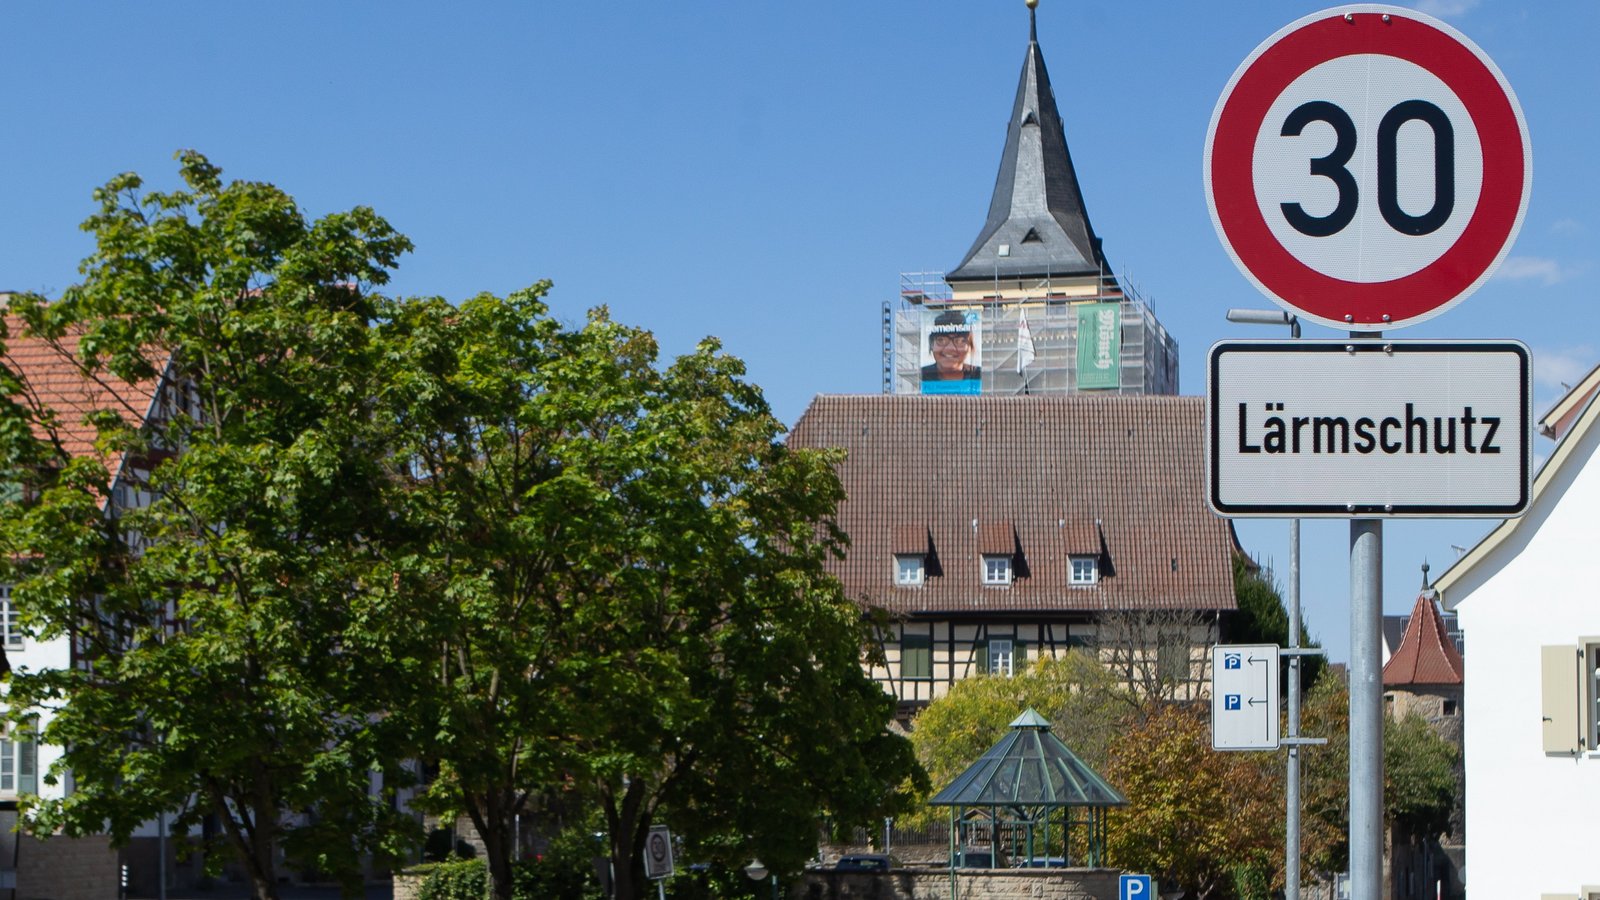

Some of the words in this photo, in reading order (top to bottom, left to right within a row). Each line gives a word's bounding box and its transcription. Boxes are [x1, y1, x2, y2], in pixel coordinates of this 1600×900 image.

[1280, 100, 1454, 237] 30
[1238, 402, 1501, 454] Lärmschutz
[1229, 658, 1238, 669] P
[1229, 696, 1238, 709] P
[1127, 879, 1143, 900] P
